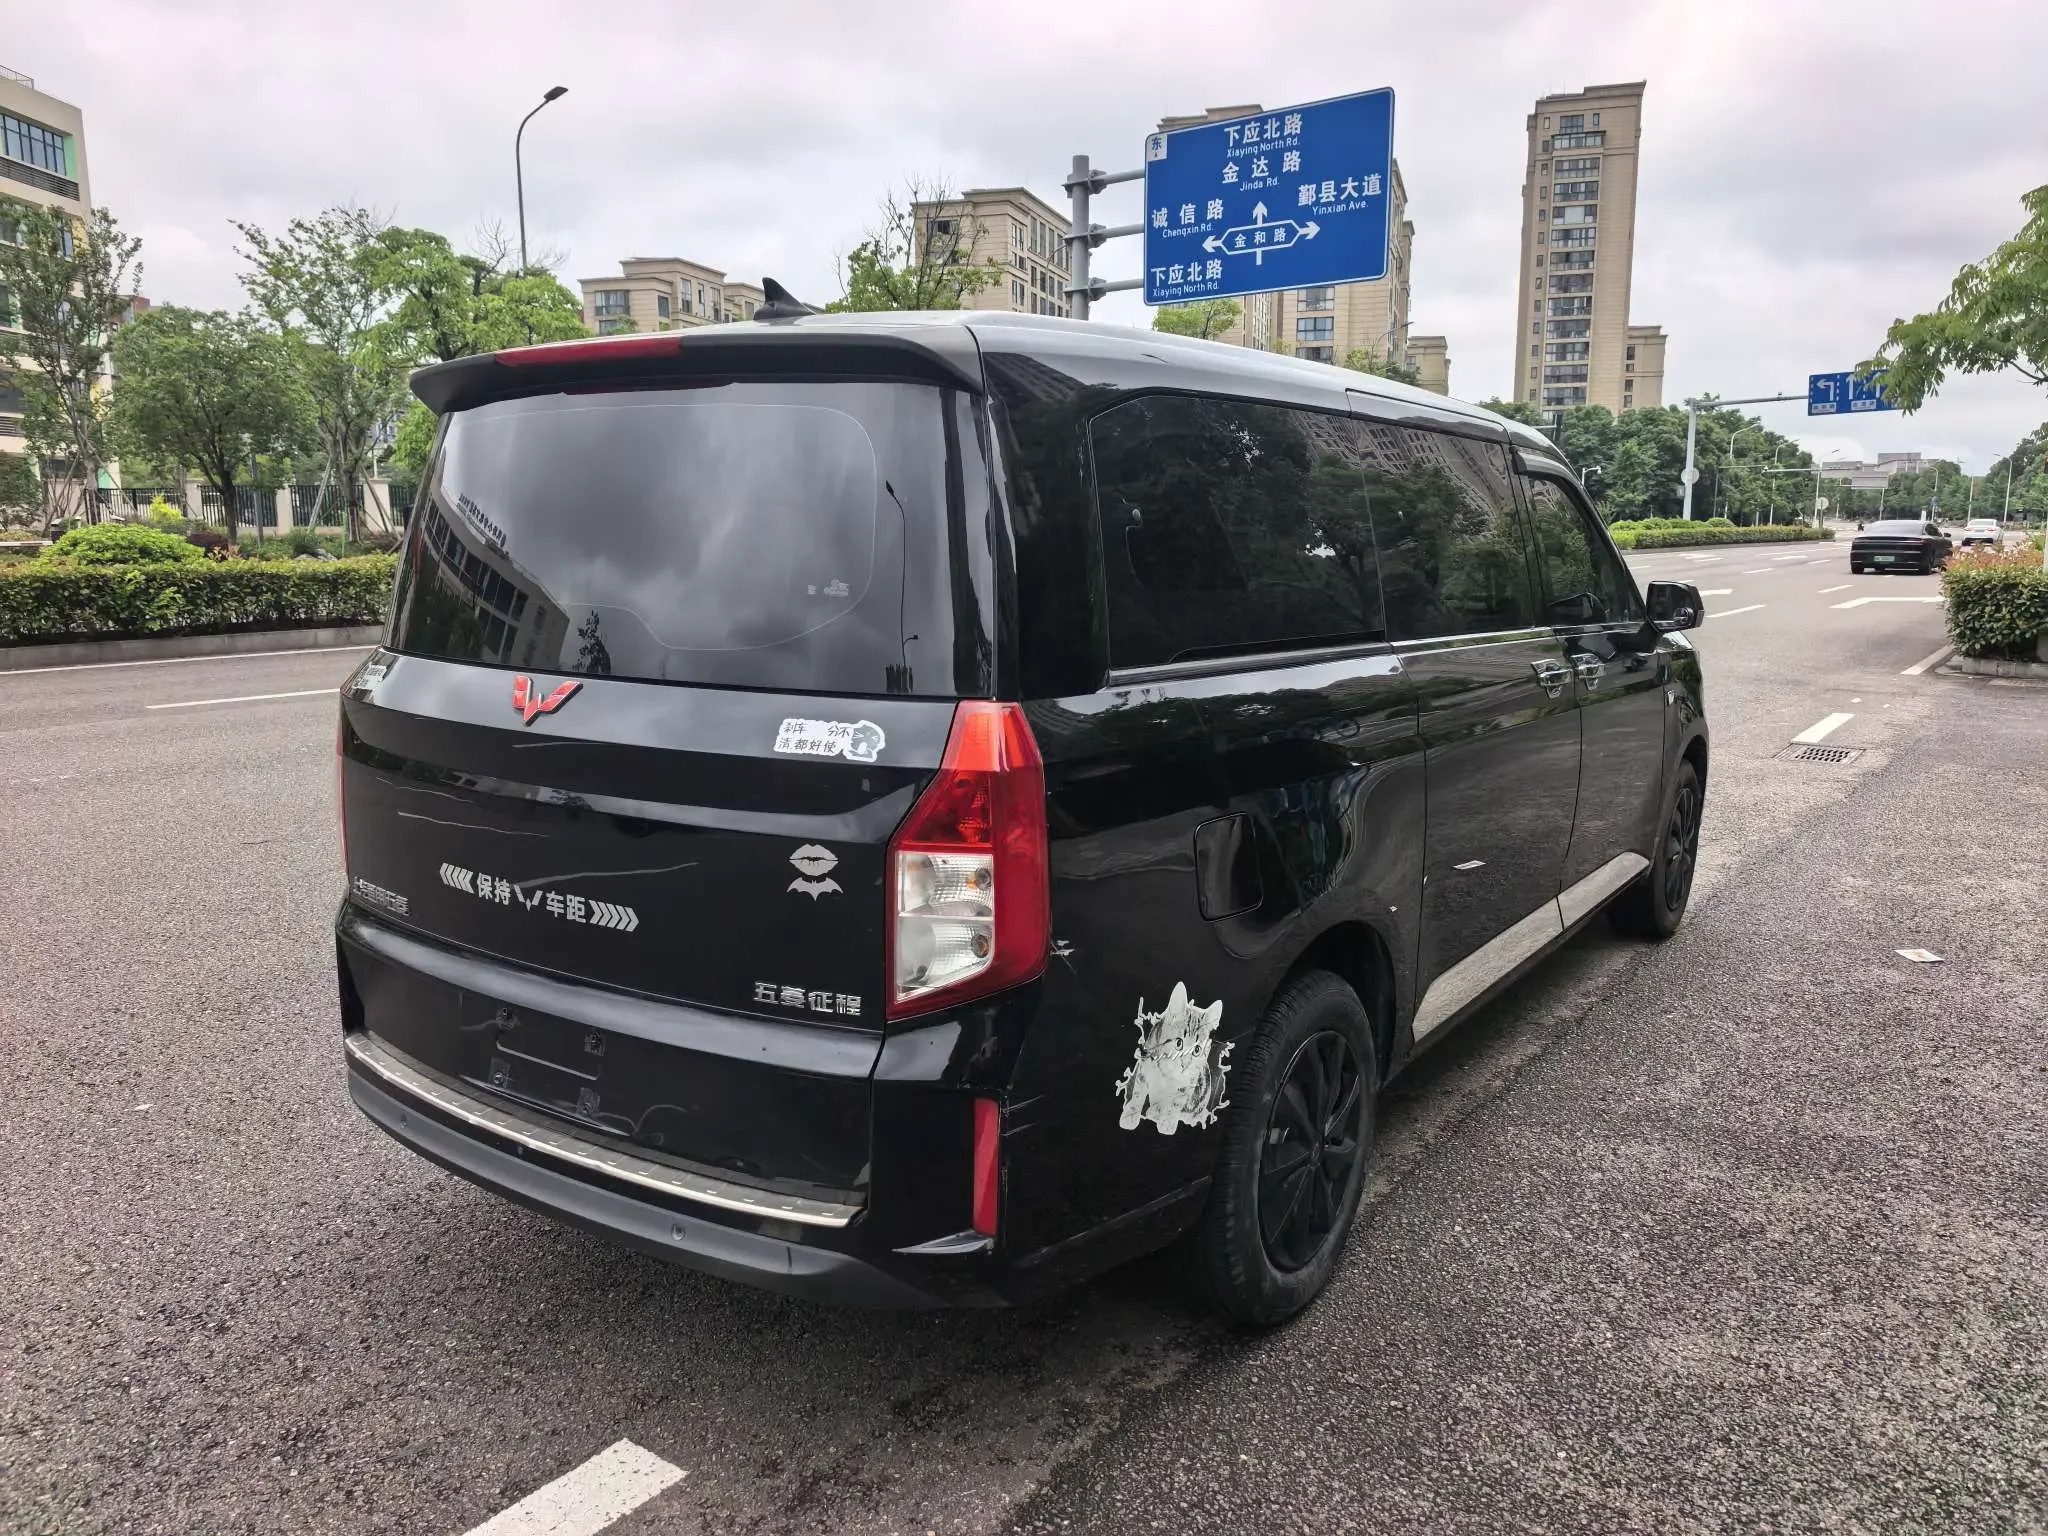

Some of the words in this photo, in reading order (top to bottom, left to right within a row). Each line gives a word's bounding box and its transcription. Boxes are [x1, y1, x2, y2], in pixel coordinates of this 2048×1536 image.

[1224, 112, 1303, 147] 下应北路
[1227, 145, 1258, 159] Xiaying
[1260, 140, 1284, 152] North
[1286, 136, 1301, 147] Rd.
[1222, 150, 1301, 184] 金达路
[1240, 180, 1263, 191] Jinda
[1267, 176, 1280, 187] Rd.
[1297, 173, 1382, 206] 鄞县大道
[1152, 198, 1224, 228] 诚信路
[1312, 204, 1346, 216] Yinxian
[1349, 200, 1369, 210] Ave.
[1162, 225, 1199, 238] Chengxin
[1200, 222, 1214, 232] Rd.
[1234, 227, 1287, 248] 金和路
[1151, 258, 1223, 287] 下应北路
[1153, 286, 1182, 298] Xiaying
[1184, 283, 1206, 293] North
[1207, 280, 1220, 290] Rd.
[477, 872, 511, 905] 保持
[546, 890, 586, 923] 车距
[753, 981, 862, 1016] 五菱征程
